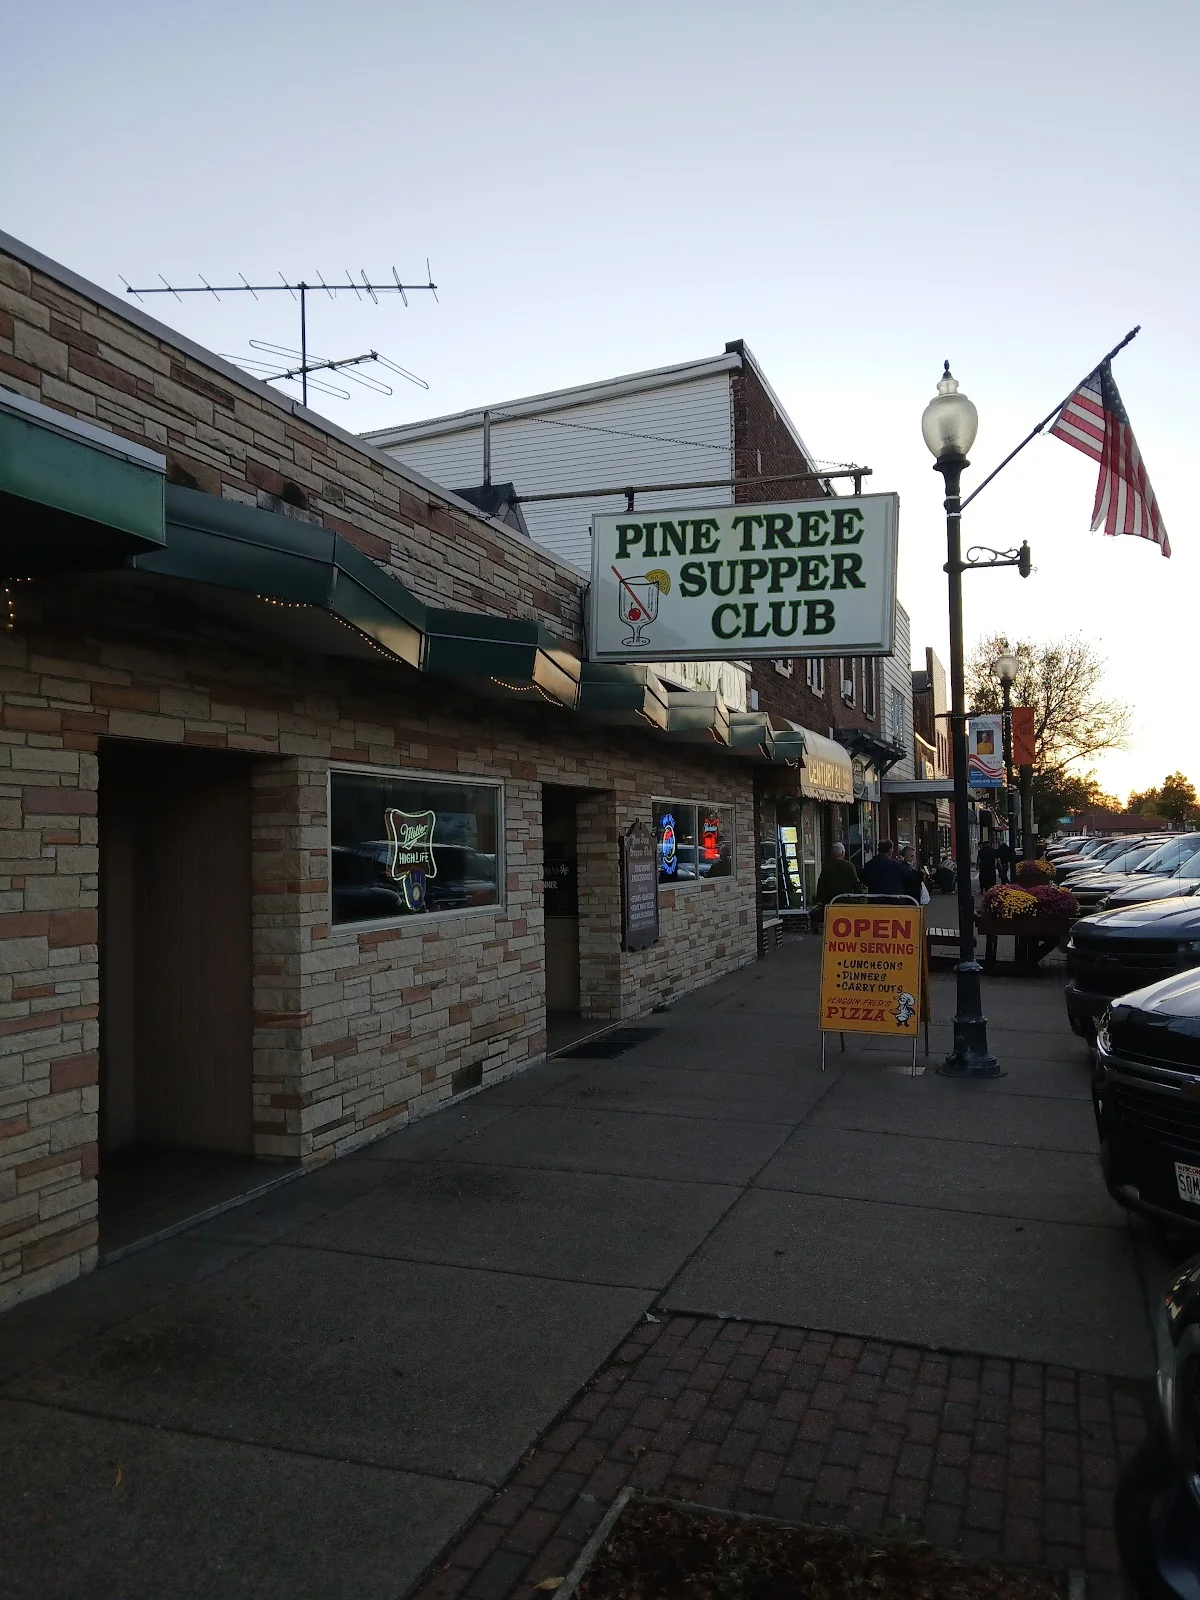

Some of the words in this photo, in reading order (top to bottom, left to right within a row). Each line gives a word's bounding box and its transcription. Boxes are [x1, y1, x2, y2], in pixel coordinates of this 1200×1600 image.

[615, 517, 721, 560] PINE
[731, 507, 865, 552] TREE
[679, 552, 867, 598] SUPPER
[711, 598, 836, 640] CLUB
[808, 759, 835, 788] CENTURY
[835, 765, 841, 790] 21
[400, 823, 428, 847] Miller
[399, 852, 415, 865] HIGH
[415, 851, 429, 863] LIFE
[832, 917, 912, 940] OPEN
[828, 941, 857, 953] NOW
[860, 942, 914, 955] SERVING
[843, 959, 903, 971] LUNCHEONS
[842, 970, 887, 982] DINNERS
[841, 982, 876, 993] CARRY
[878, 983, 904, 994] OUTS
[826, 1006, 887, 1022] PIZZA
